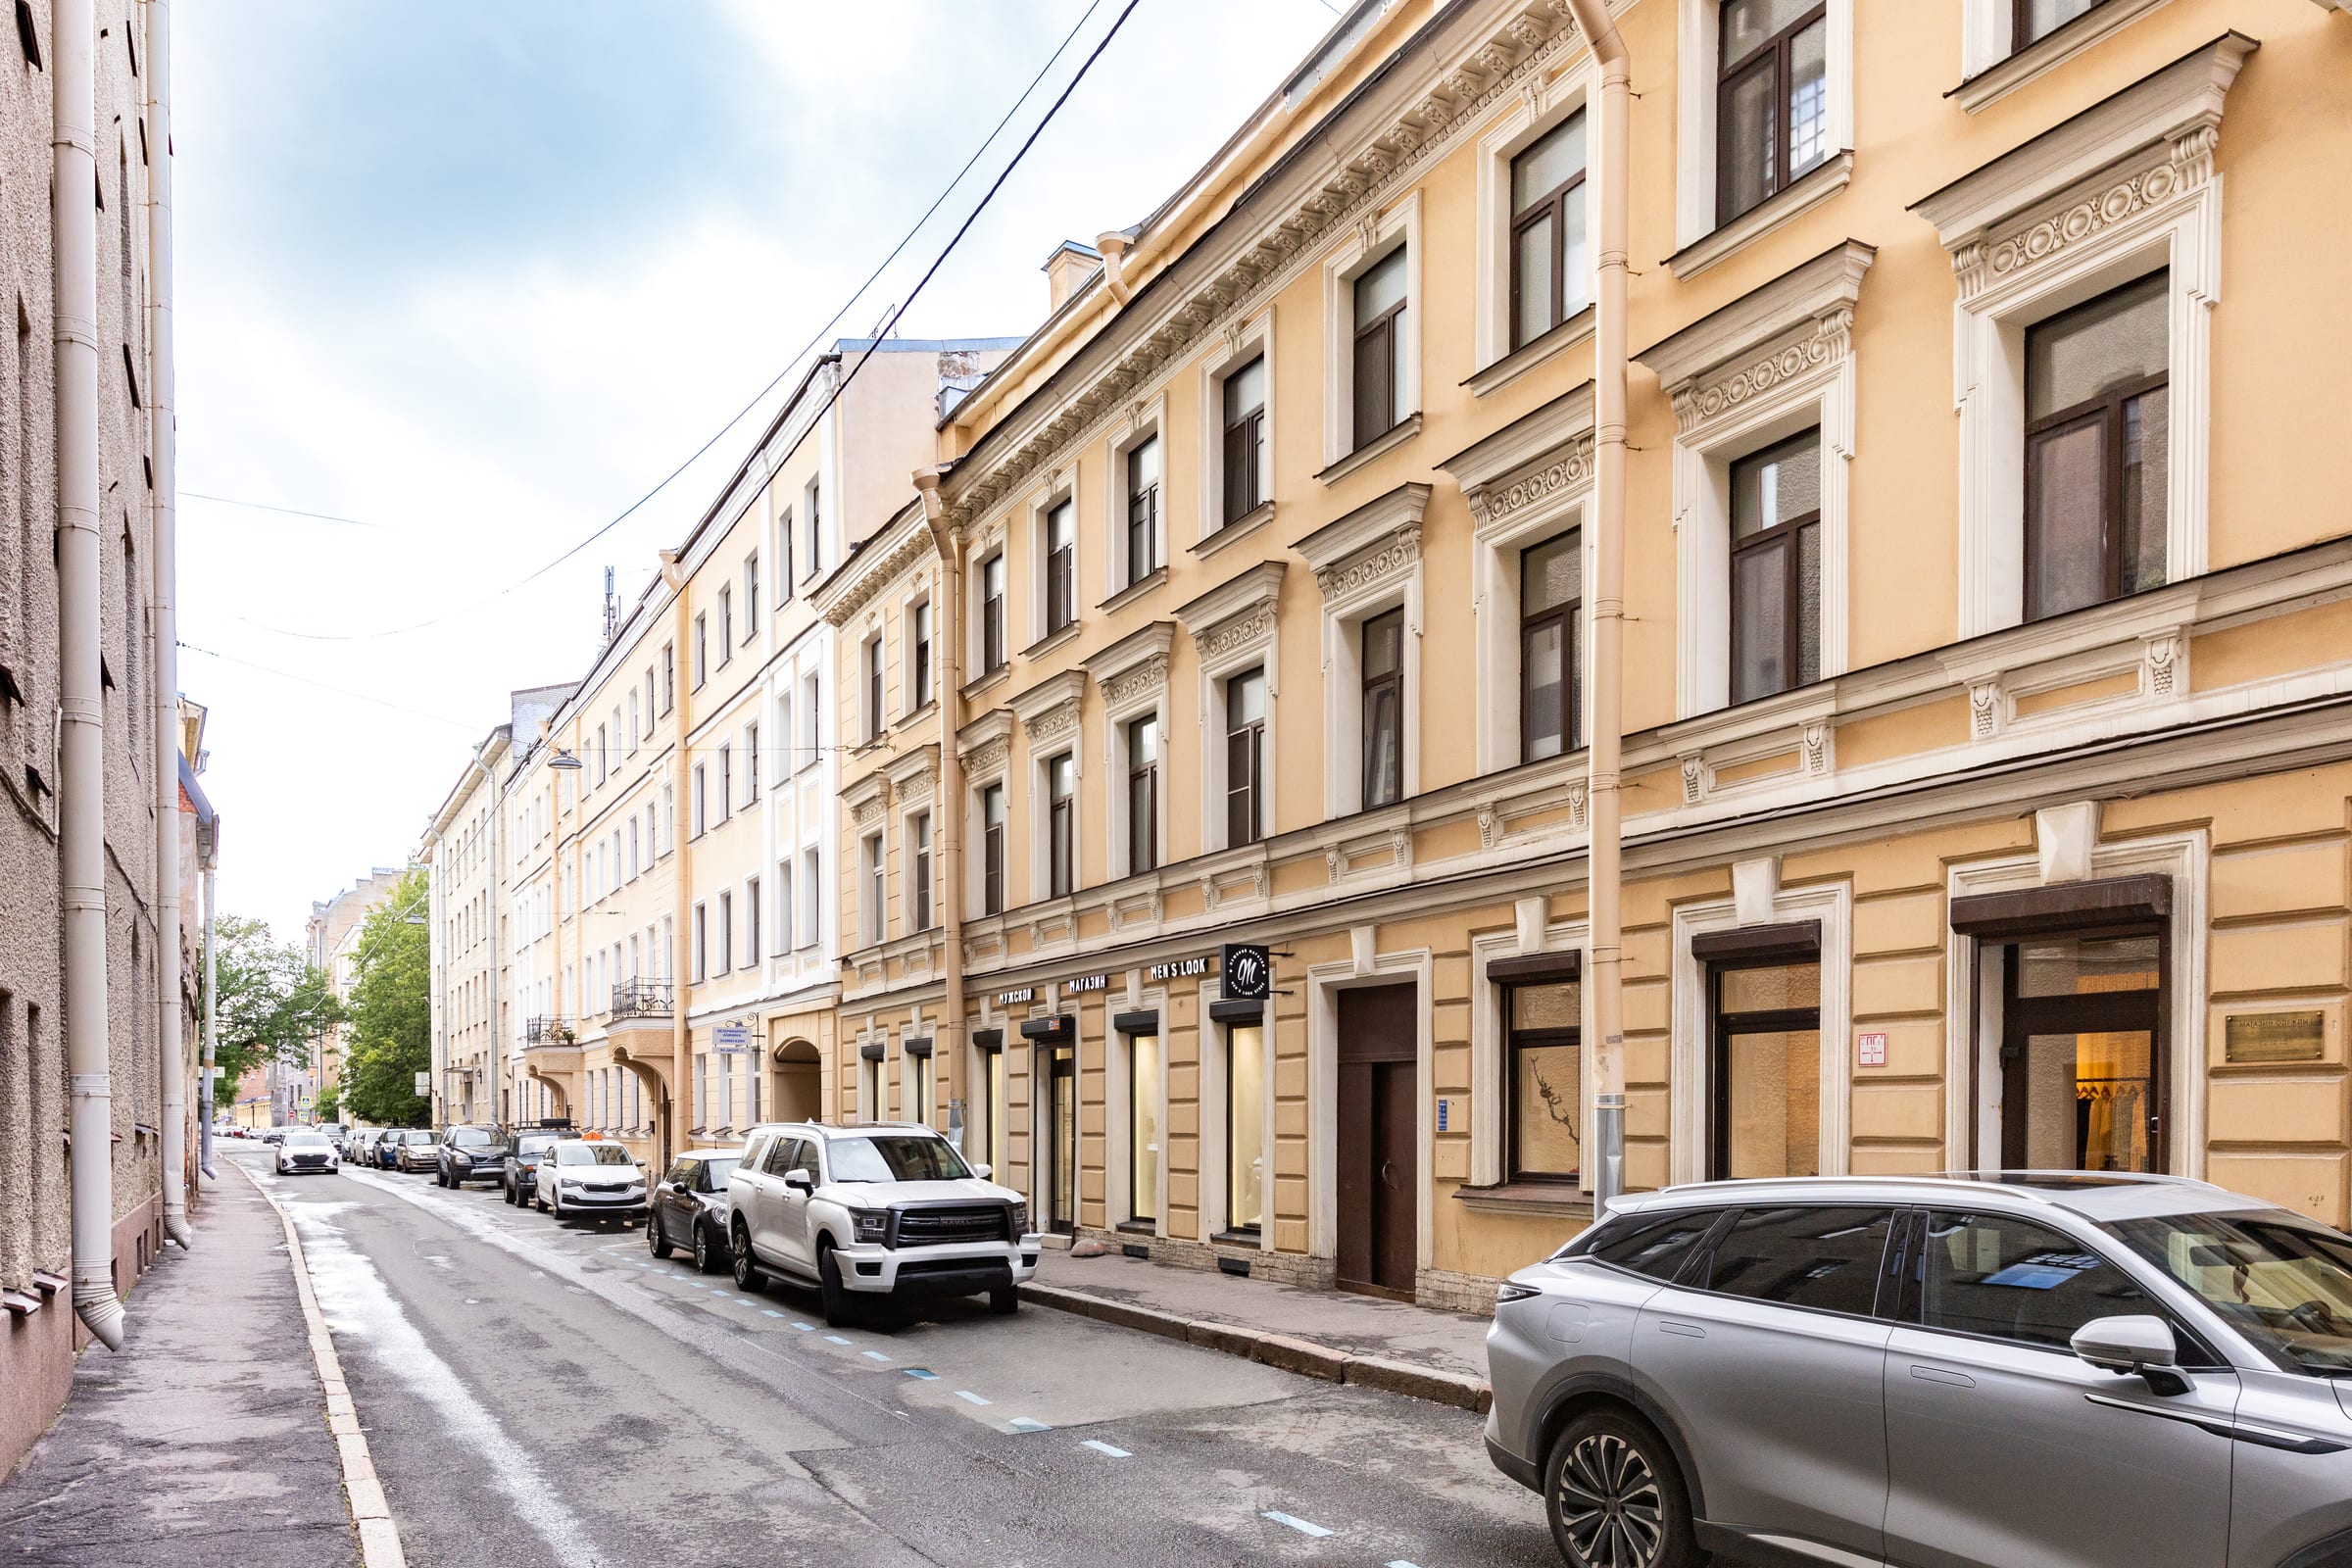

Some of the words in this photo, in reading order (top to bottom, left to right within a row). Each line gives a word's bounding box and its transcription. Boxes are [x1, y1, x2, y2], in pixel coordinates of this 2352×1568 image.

[1151, 962, 1177, 980] MEN'S
[1181, 957, 1205, 976] LOOK
[999, 987, 1032, 1004] МУЖСКОЙ
[1069, 974, 1105, 993] МАГАЗИН
[1866, 1036, 1878, 1046] ПГ
